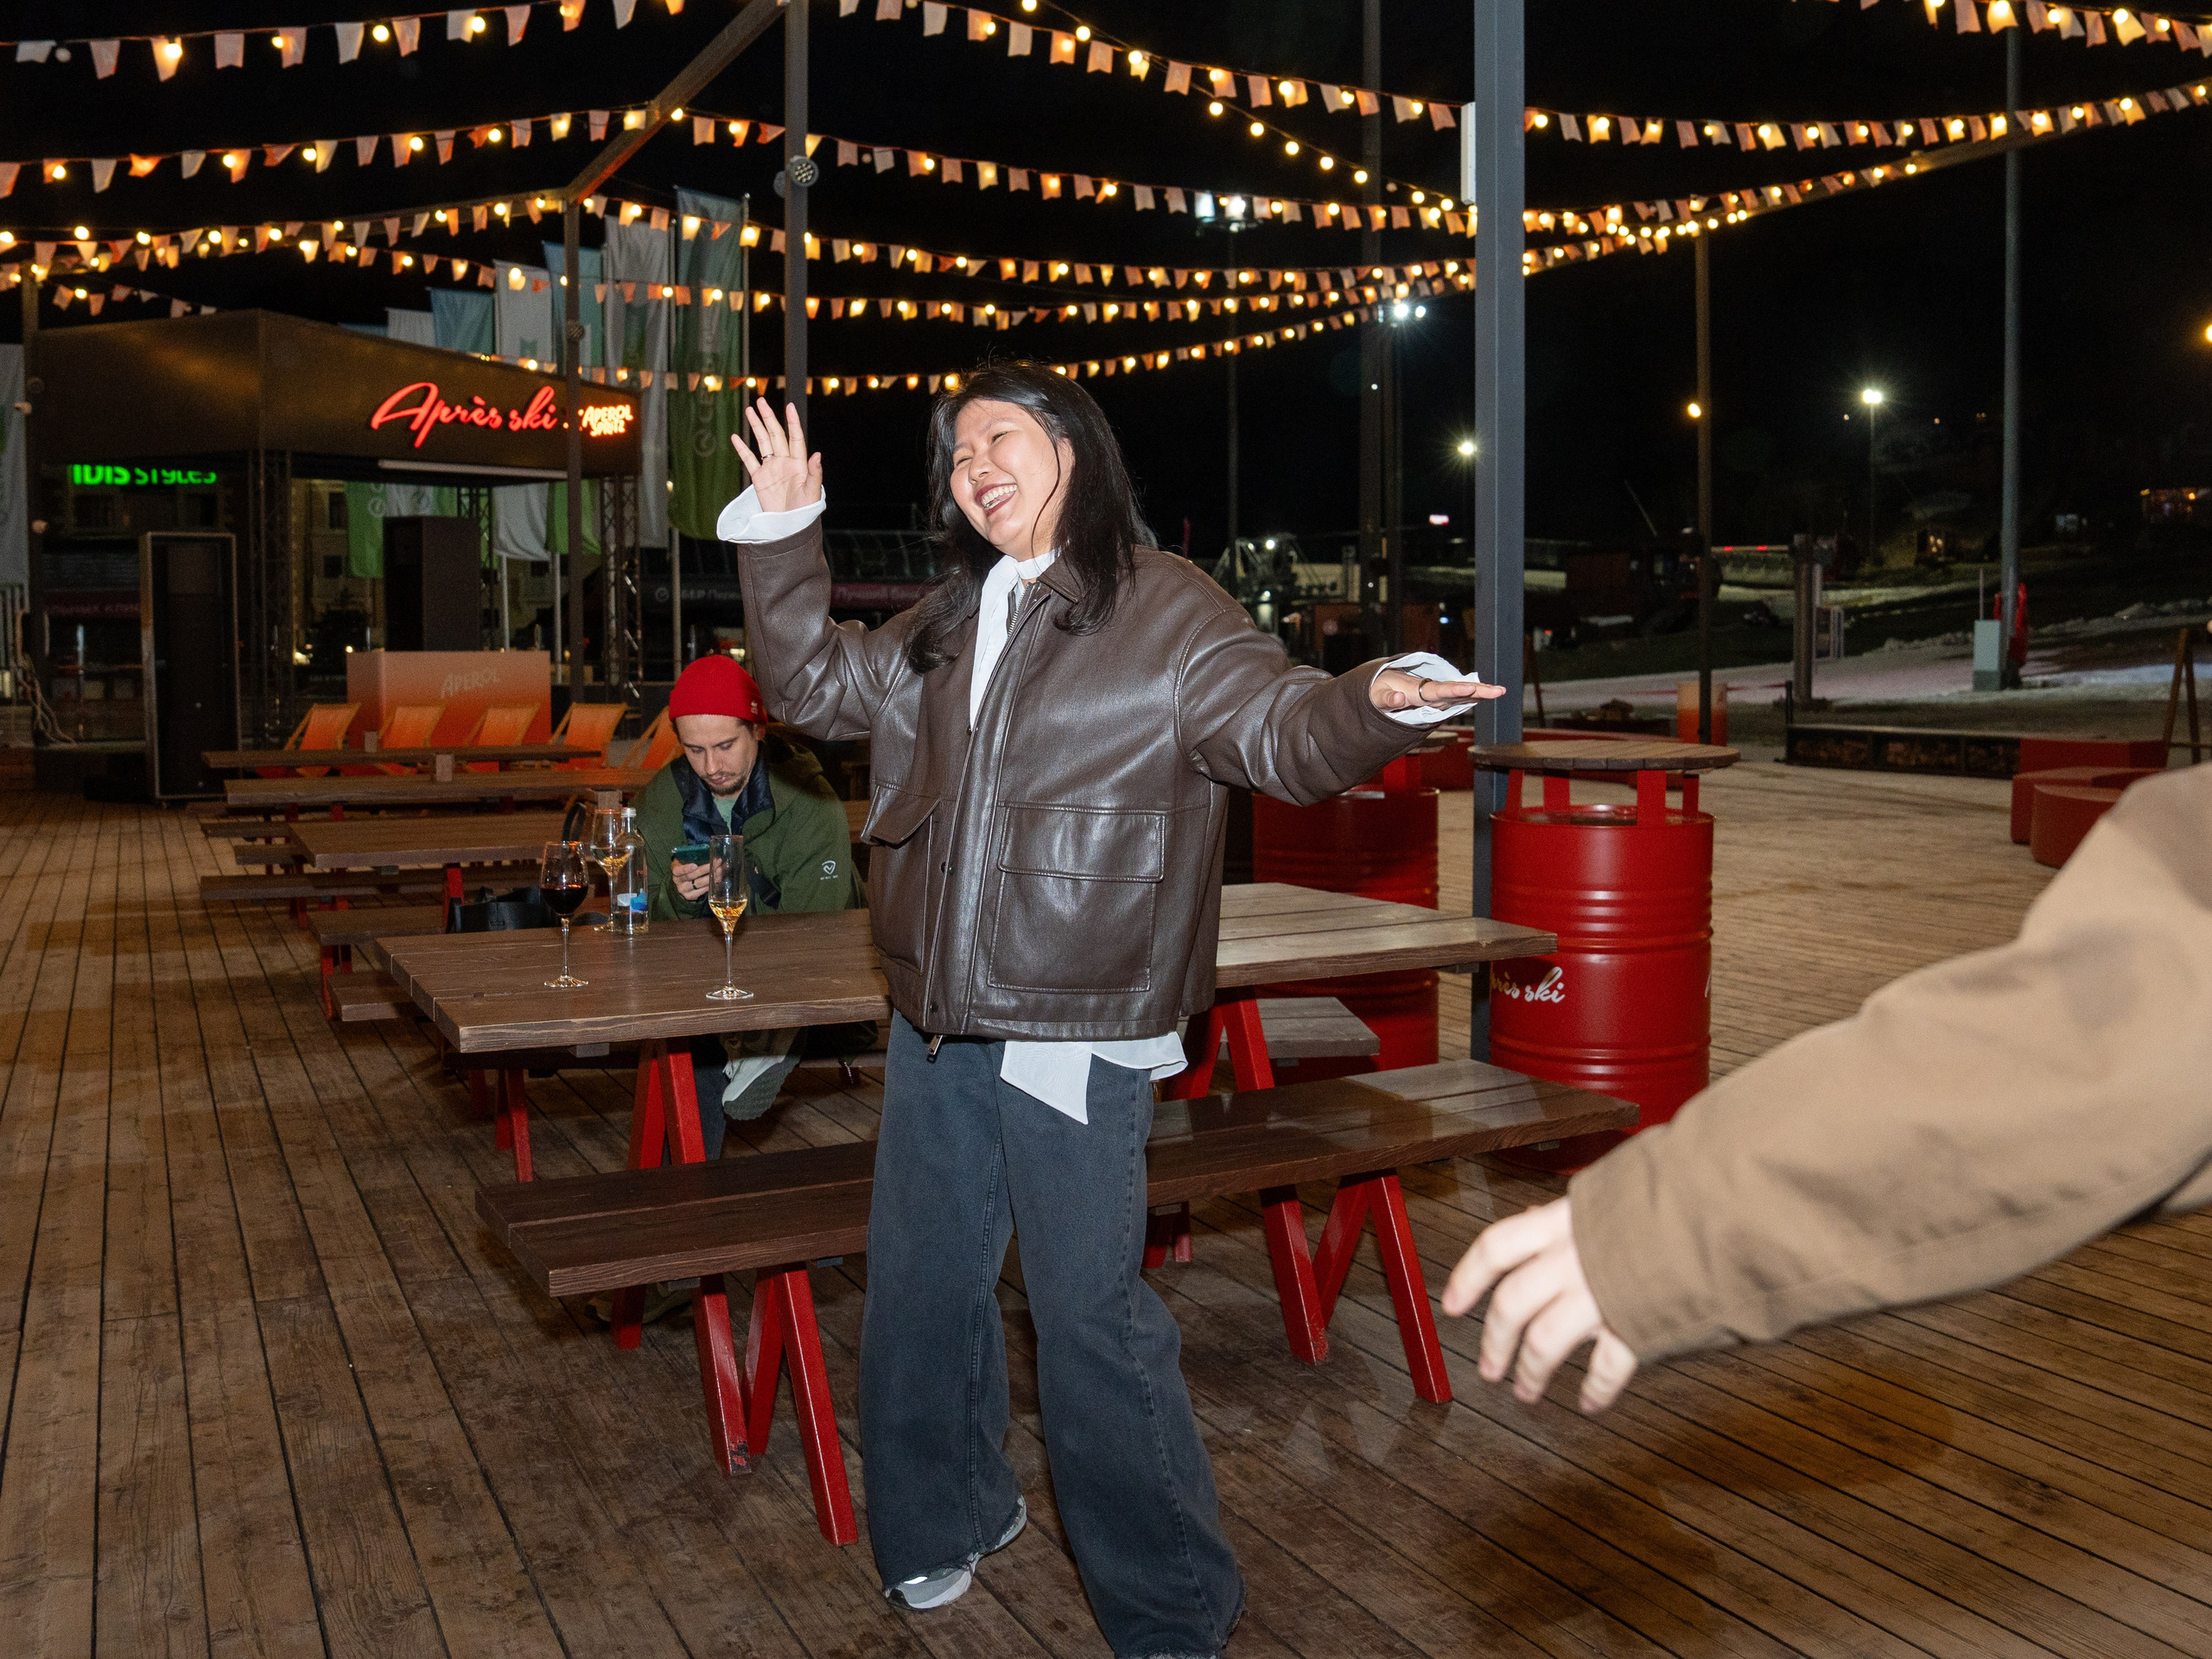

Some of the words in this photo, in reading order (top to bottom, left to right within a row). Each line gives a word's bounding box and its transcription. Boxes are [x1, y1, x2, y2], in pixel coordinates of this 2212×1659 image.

[371, 382, 503, 448] Après
[508, 385, 558, 431] ski
[582, 404, 633, 429] APEROL
[440, 668, 501, 699] APEROL
[1524, 966, 1566, 1003] ski
